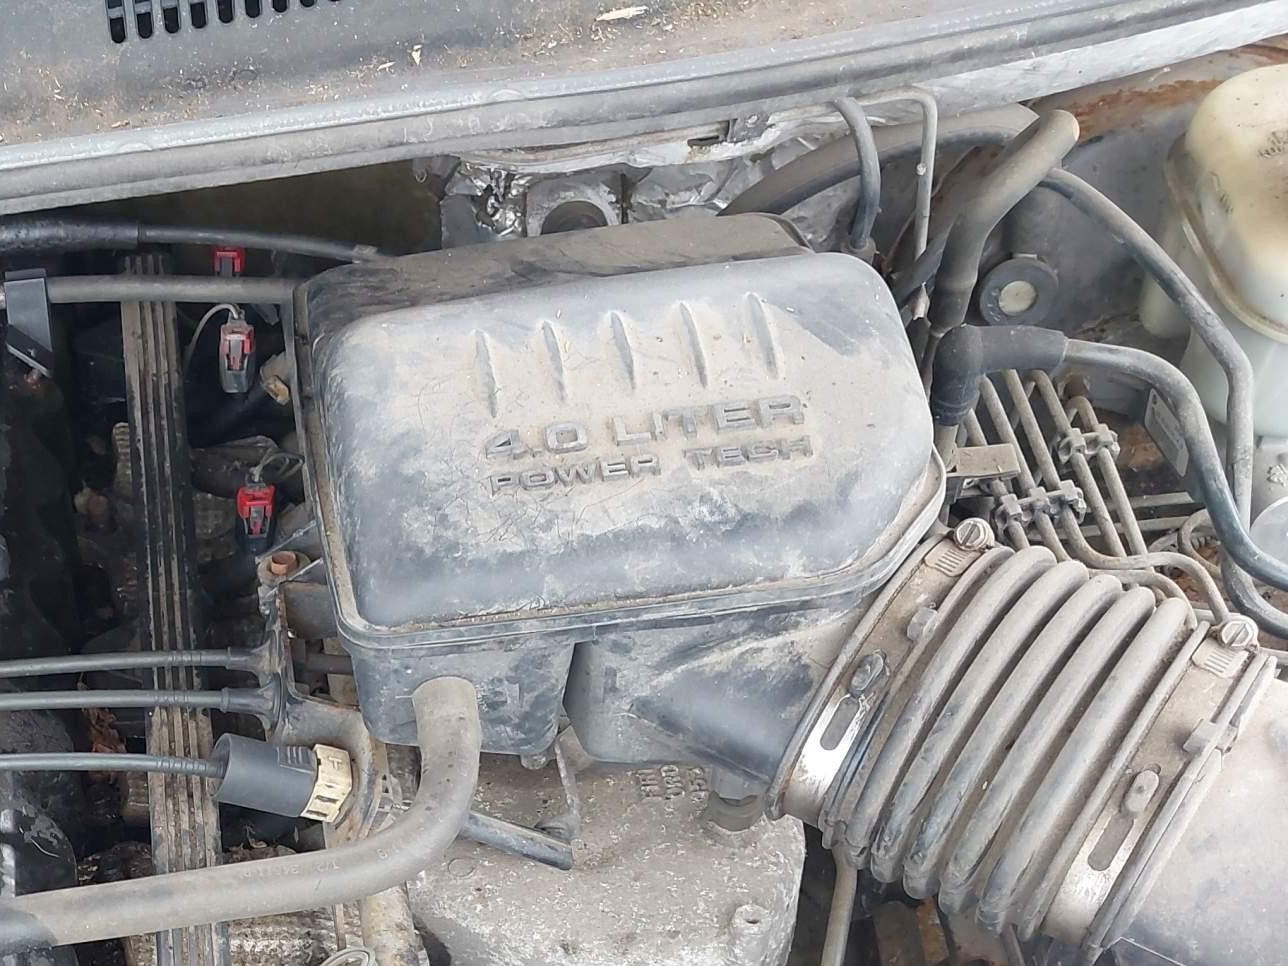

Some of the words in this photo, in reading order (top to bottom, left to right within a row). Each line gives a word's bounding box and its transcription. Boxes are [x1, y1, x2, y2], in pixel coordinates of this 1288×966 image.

[485, 420, 589, 457] 4.0
[611, 395, 805, 447] LITER
[489, 454, 661, 496] POWER
[683, 435, 813, 471] TECH
